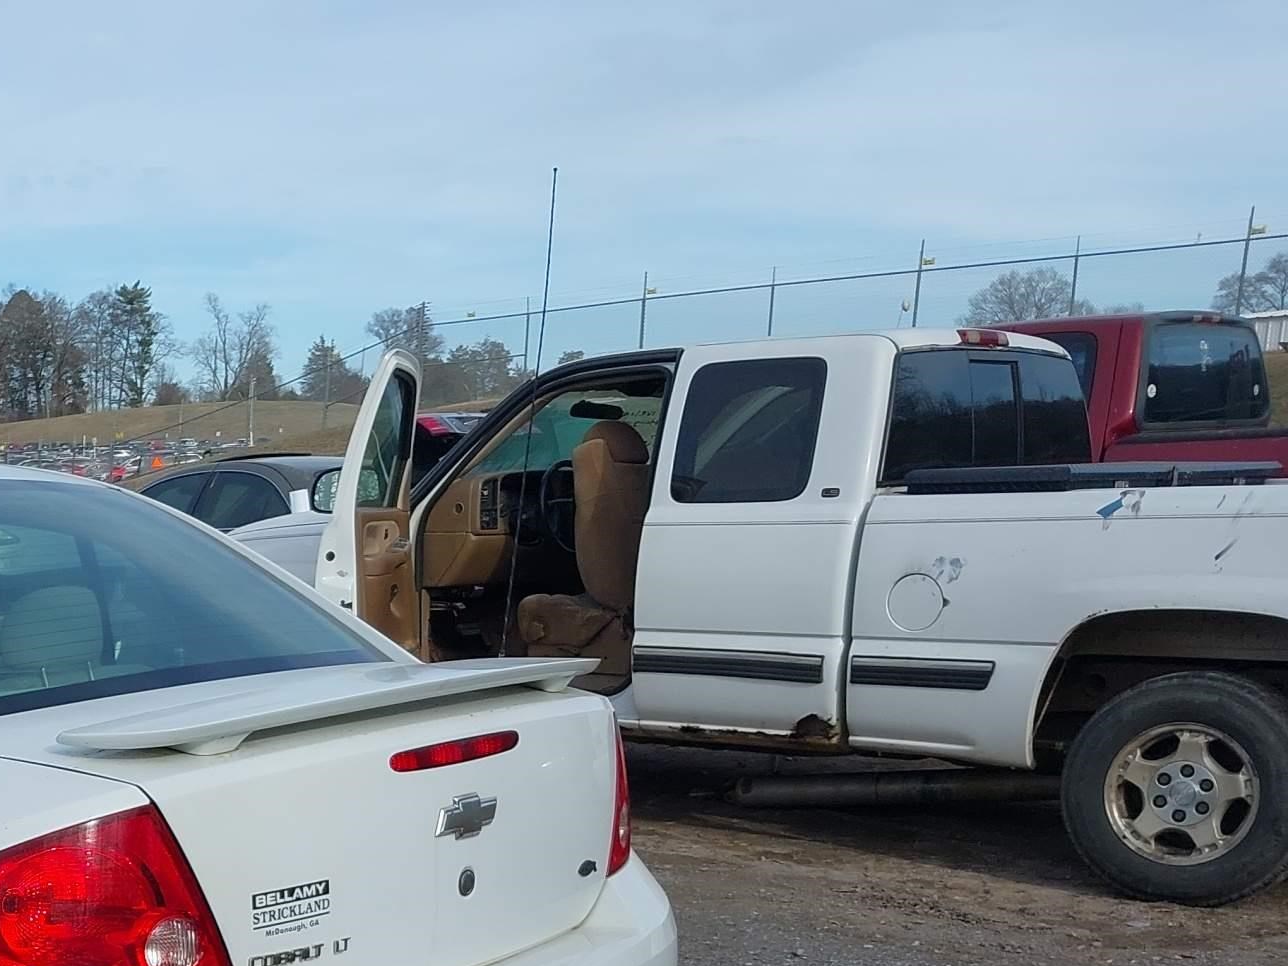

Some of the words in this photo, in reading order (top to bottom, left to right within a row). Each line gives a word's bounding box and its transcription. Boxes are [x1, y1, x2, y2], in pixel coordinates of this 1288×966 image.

[254, 881, 327, 908] BELLAMY
[252, 898, 330, 925] STRICKLAND
[309, 919, 320, 927] GA
[332, 937, 352, 955] LT
